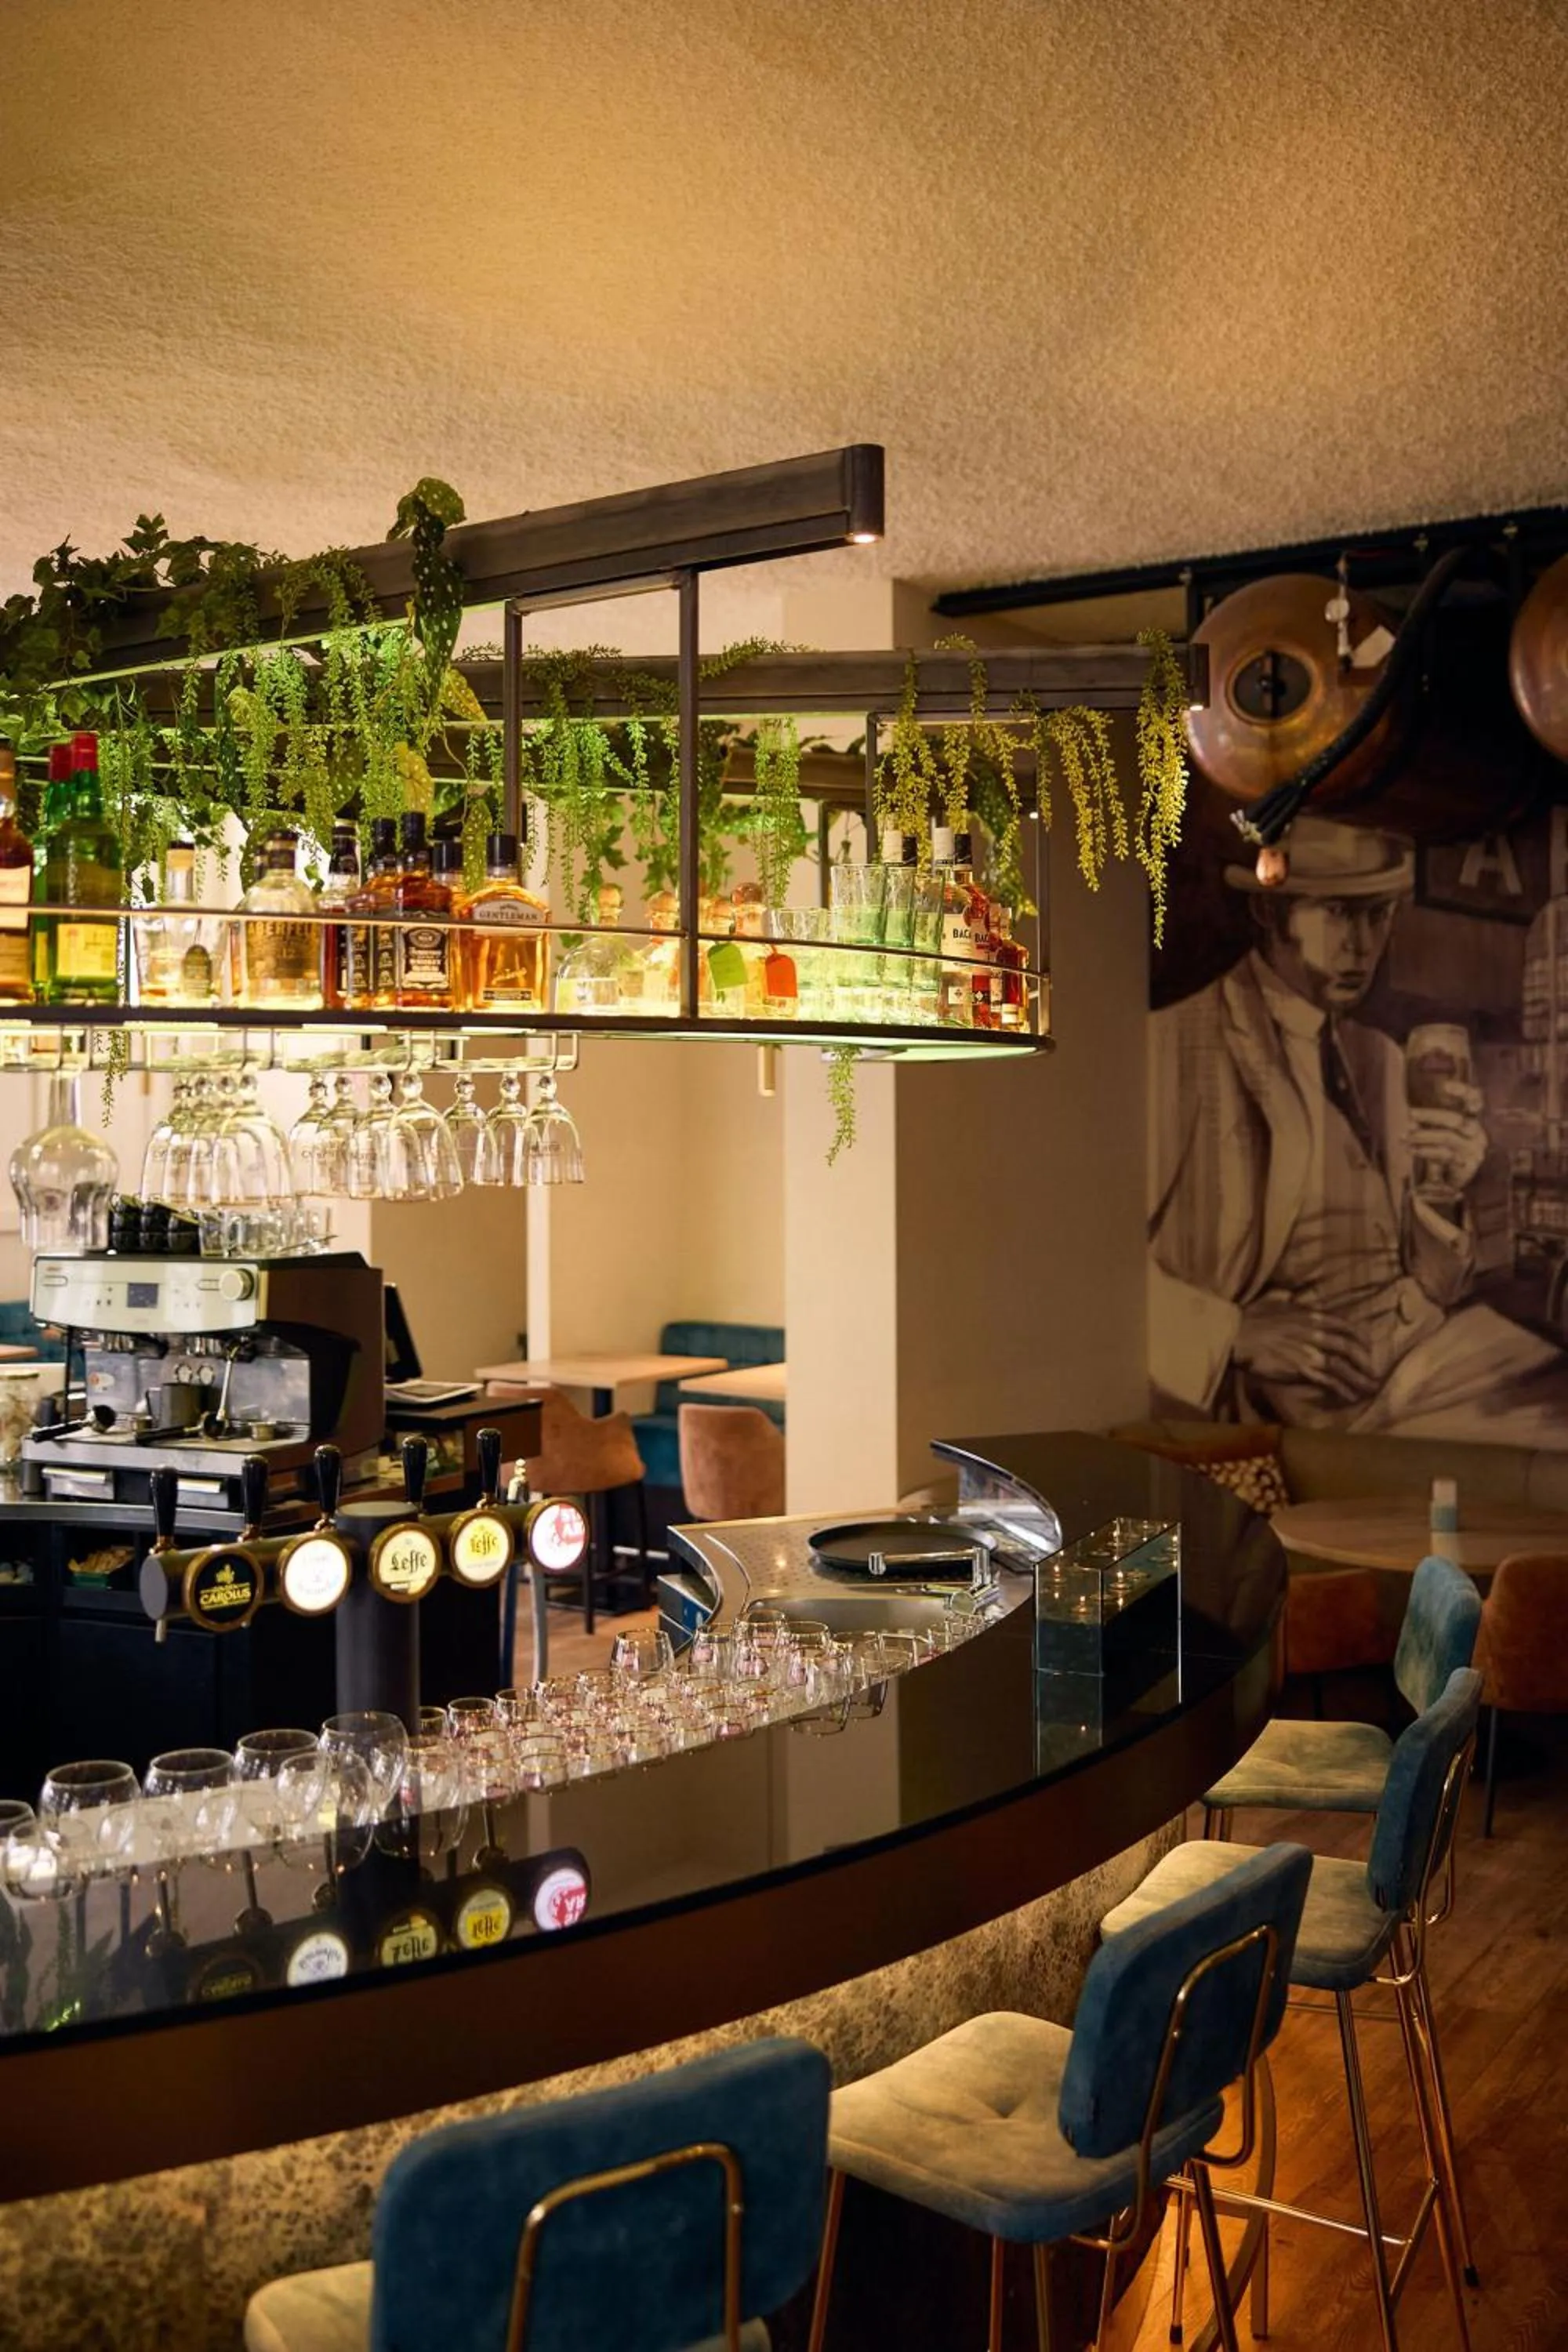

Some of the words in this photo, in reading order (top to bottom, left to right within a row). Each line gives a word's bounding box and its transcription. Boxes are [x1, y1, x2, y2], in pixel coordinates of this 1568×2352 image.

[478, 911, 538, 920] GENTLEMAN
[390, 1549, 427, 1574] Leffe
[199, 1587, 252, 1606] CAROLUS
